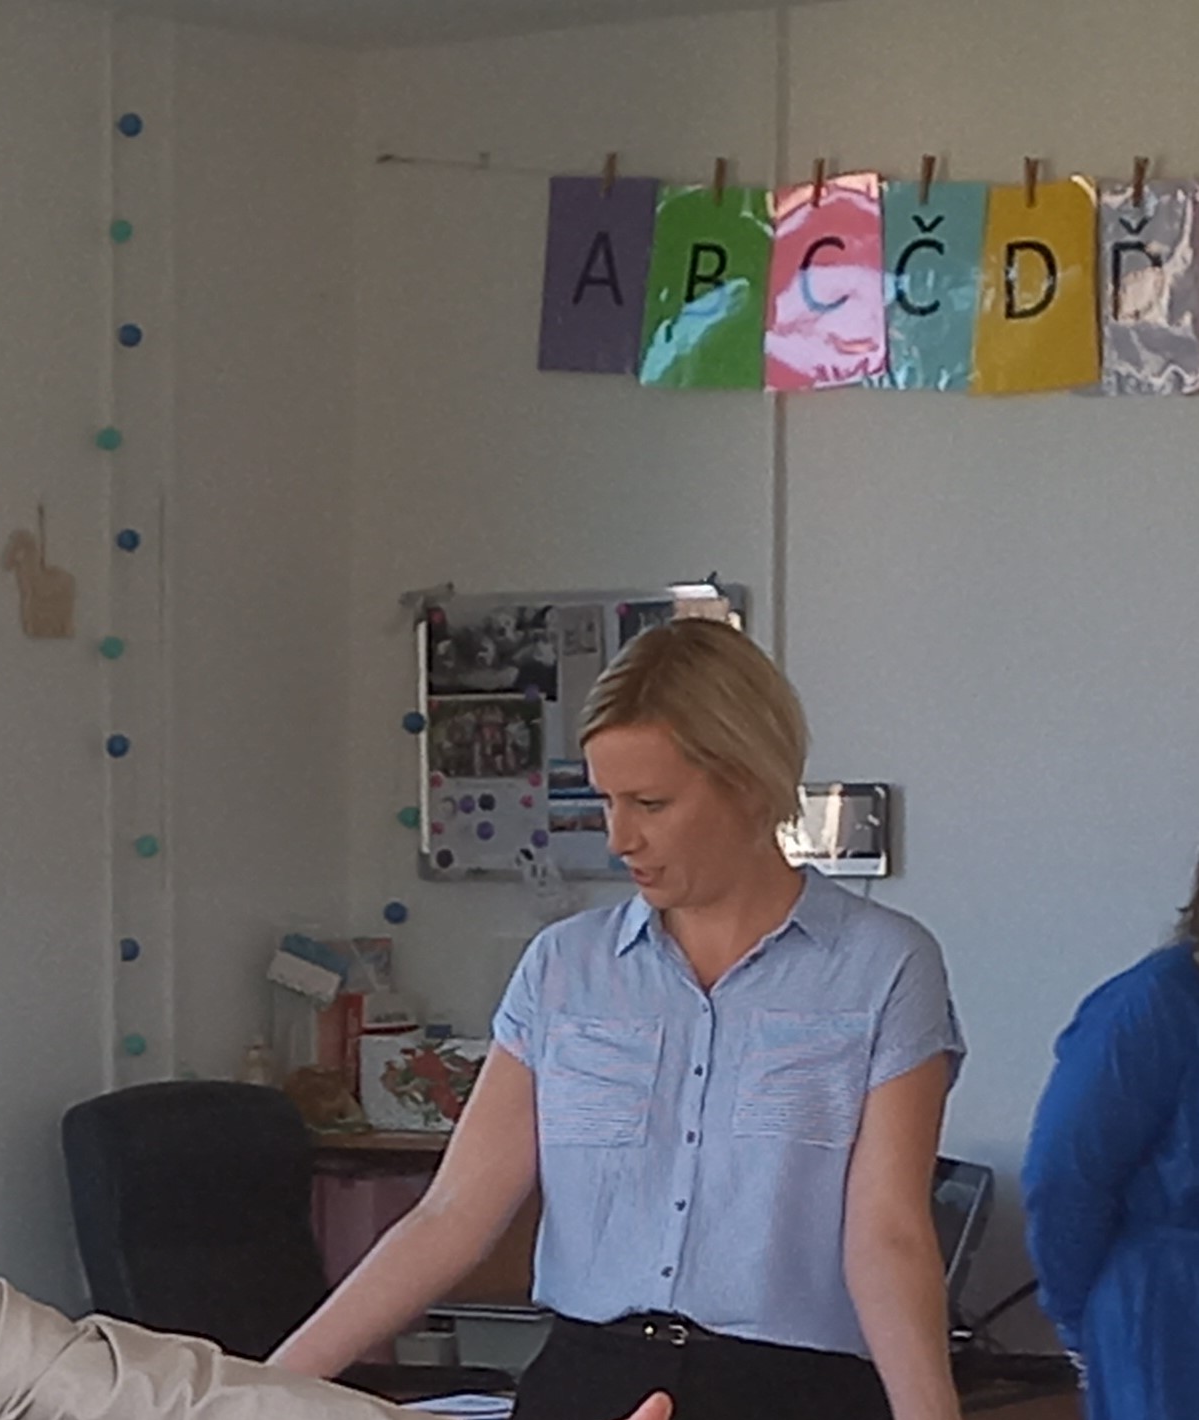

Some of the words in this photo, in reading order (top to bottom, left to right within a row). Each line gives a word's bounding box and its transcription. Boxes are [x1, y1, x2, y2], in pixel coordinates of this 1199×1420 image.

[572, 231, 624, 306] A
[682, 242, 728, 316] B
[799, 235, 850, 313] C
[895, 214, 945, 317] Č
[1004, 240, 1057, 320] D
